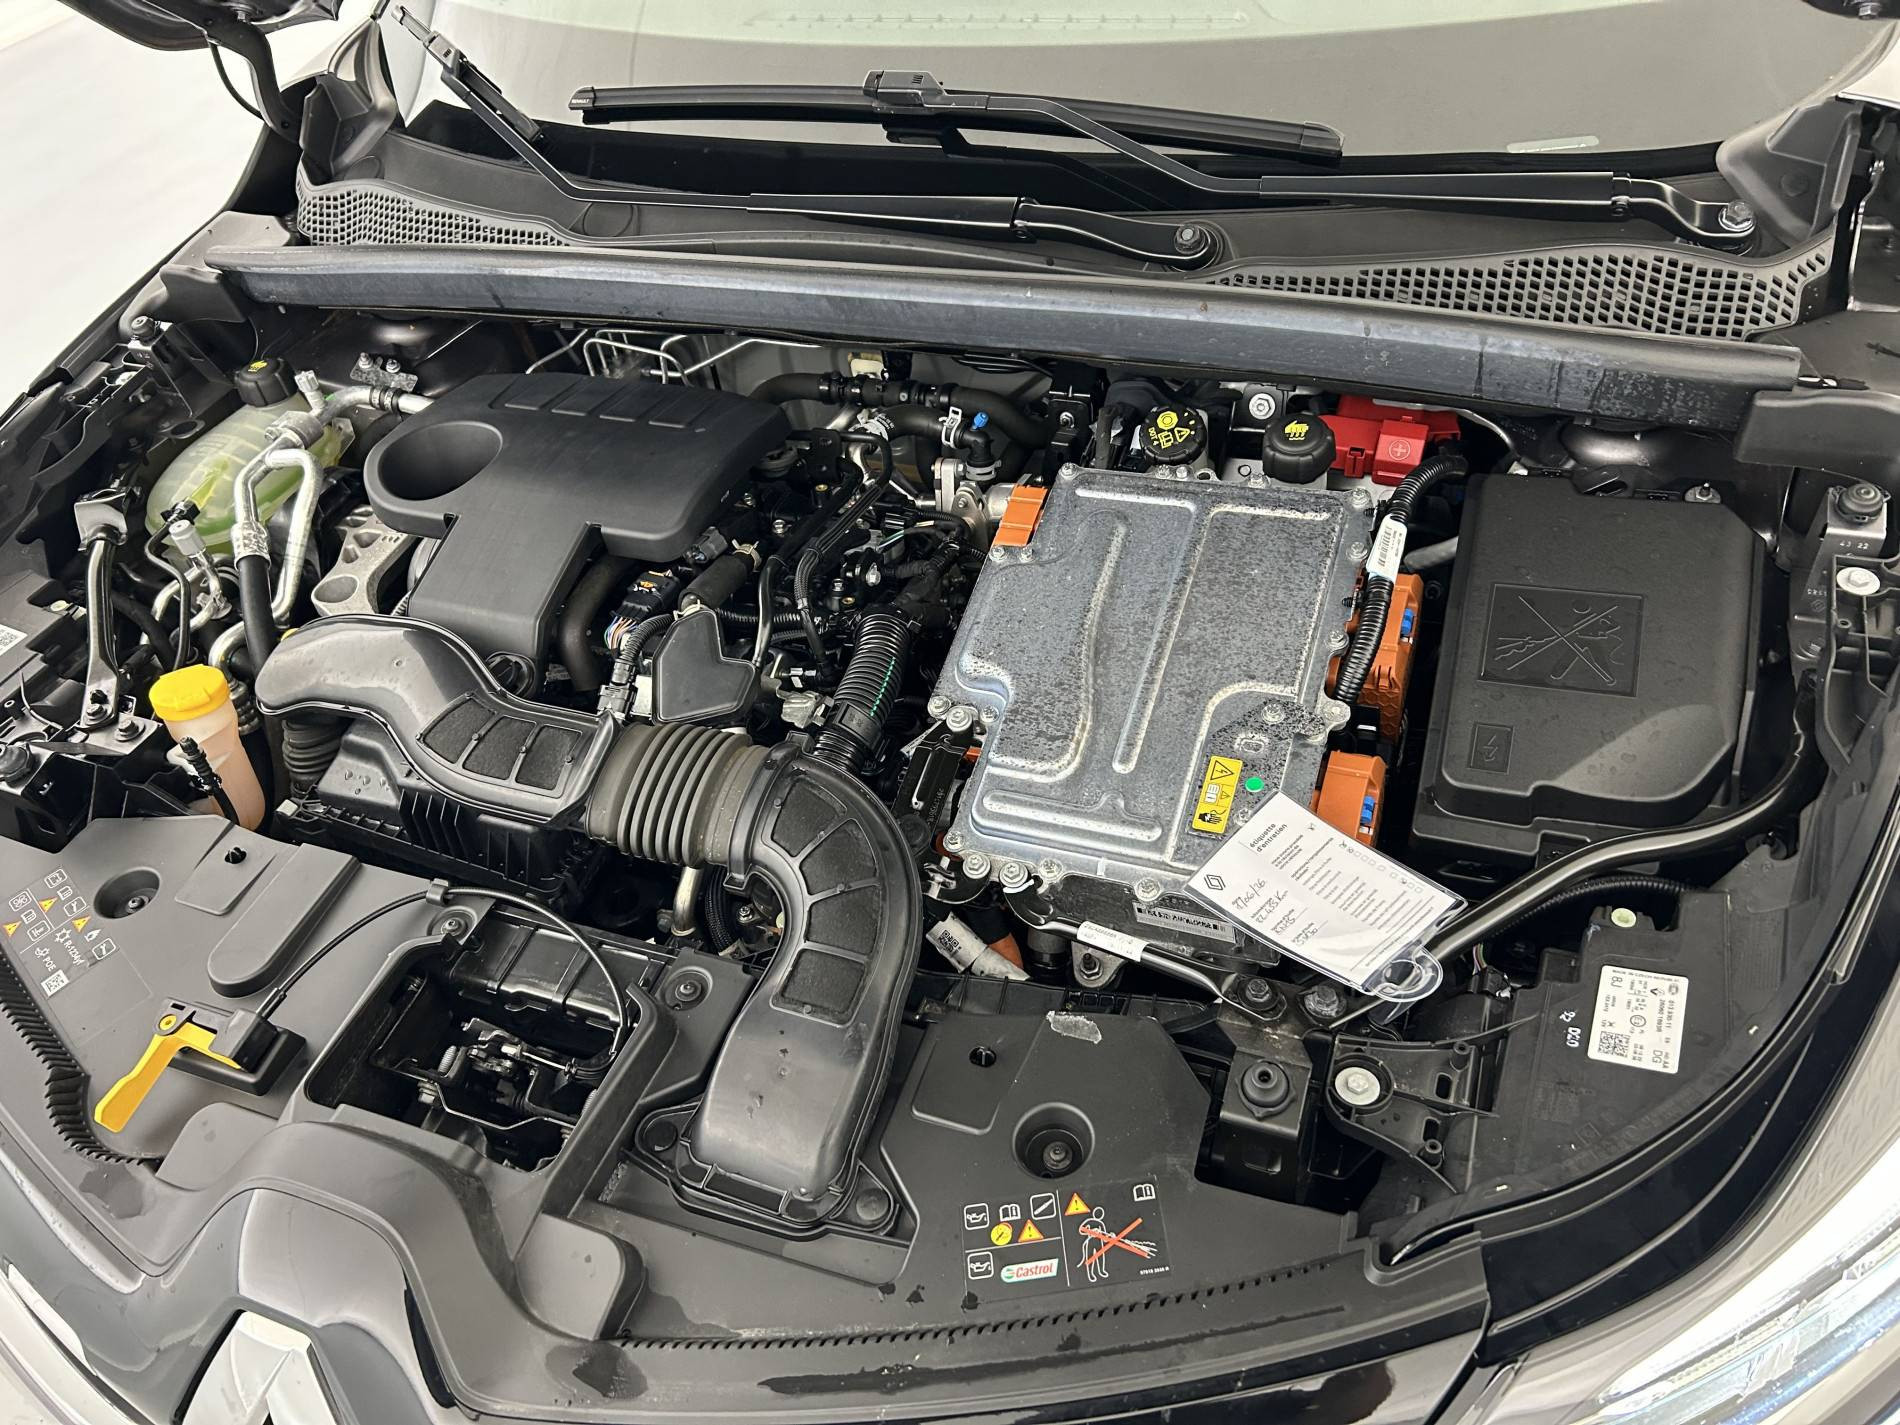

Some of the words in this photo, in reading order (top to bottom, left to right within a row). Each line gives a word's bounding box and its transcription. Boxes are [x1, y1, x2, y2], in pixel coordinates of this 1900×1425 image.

[1147, 426, 1158, 440] DOT
[43, 957, 57, 972] POE
[1611, 976, 1623, 988] 8J
[1652, 1050, 1663, 1063] DG
[1015, 1262, 1054, 1279] Castrol
